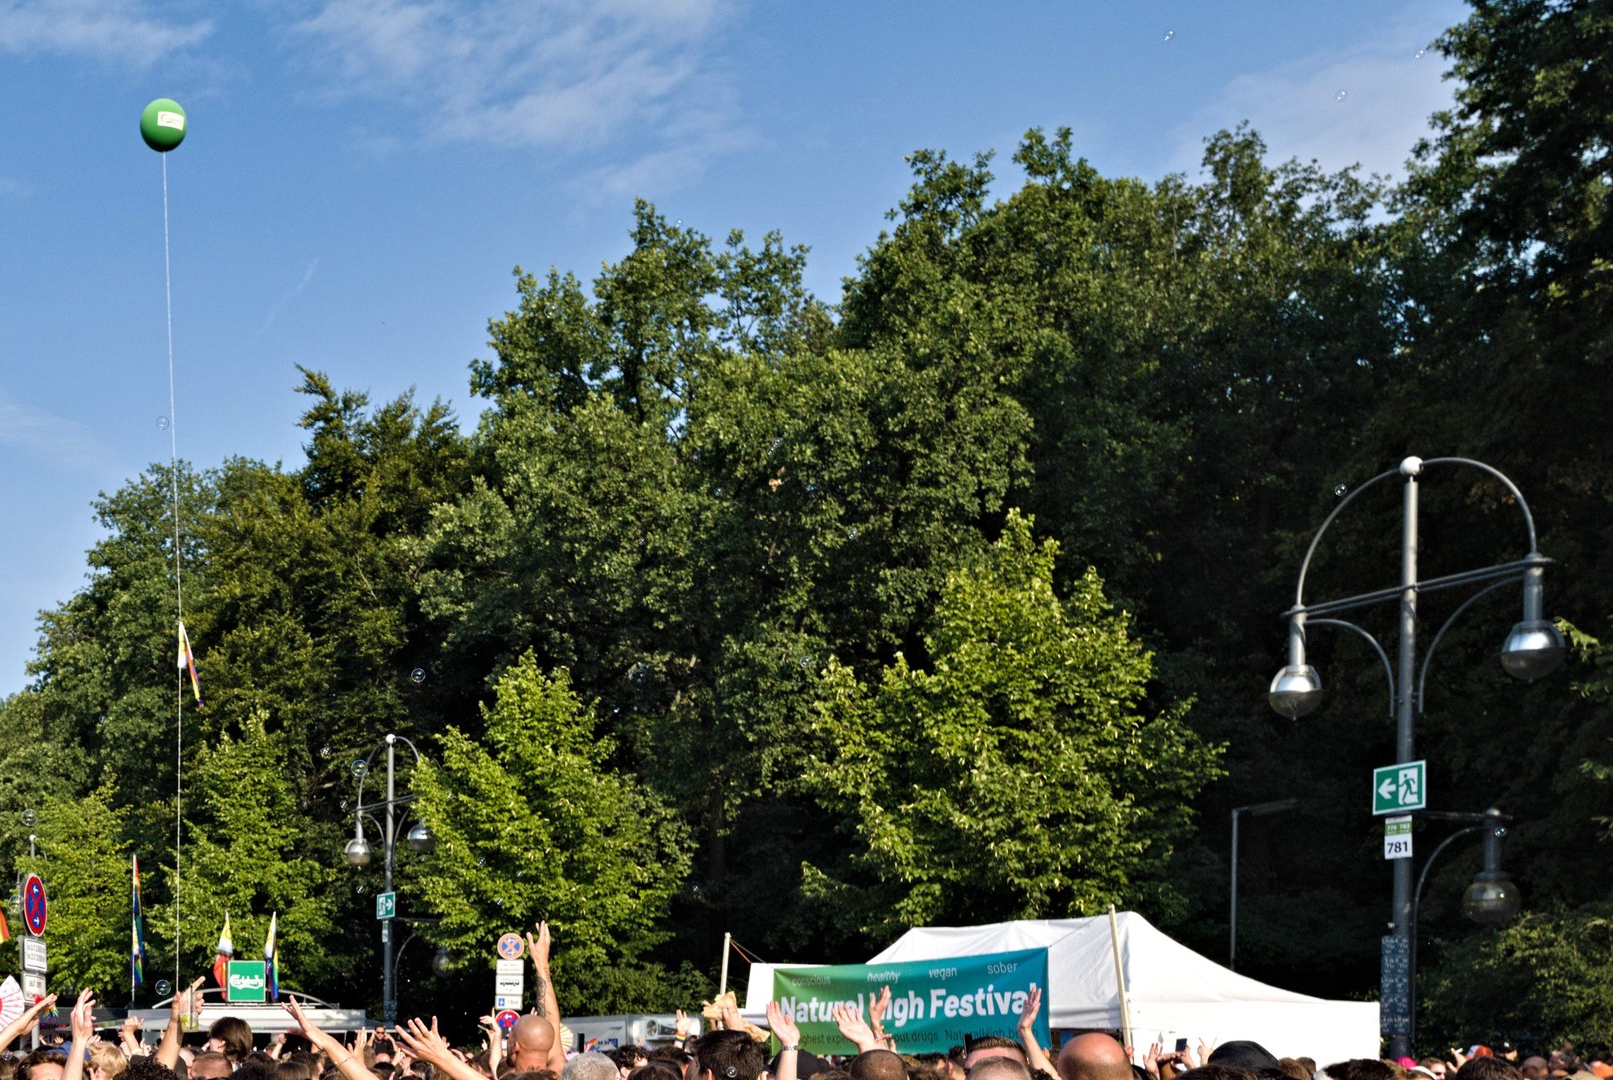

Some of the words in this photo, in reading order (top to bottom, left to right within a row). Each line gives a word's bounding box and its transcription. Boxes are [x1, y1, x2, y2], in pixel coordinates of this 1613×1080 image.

[1387, 841, 1408, 854] 781
[792, 974, 832, 987] conscious
[867, 969, 901, 984] healthy
[928, 966, 958, 980] vegan
[987, 961, 1018, 975] sober
[911, 1031, 939, 1044] drugs
